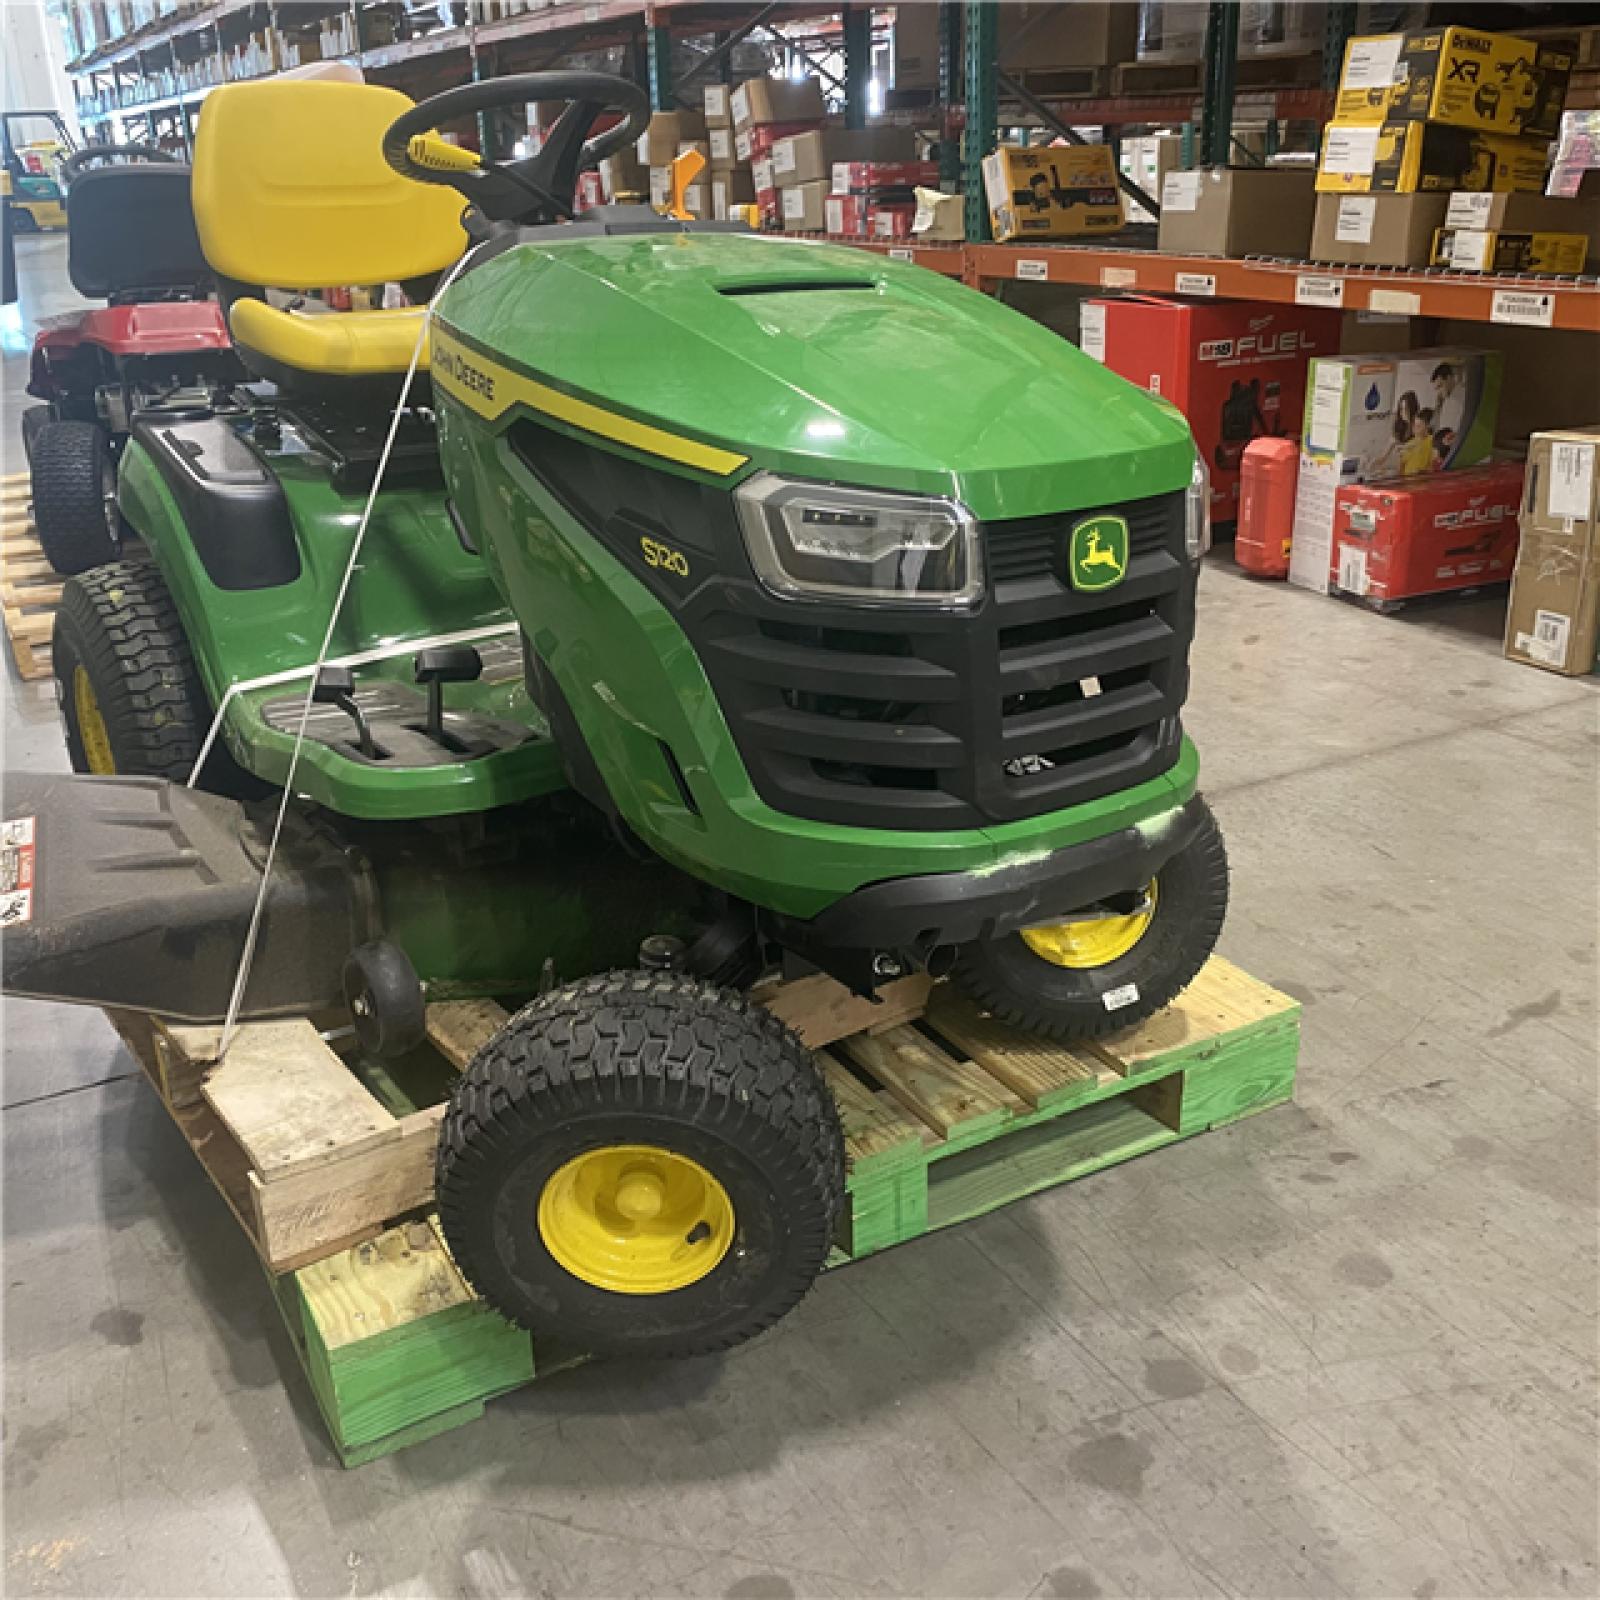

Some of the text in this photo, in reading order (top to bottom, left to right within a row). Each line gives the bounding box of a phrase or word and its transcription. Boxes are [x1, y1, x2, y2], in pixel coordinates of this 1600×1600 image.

[1447, 57, 1480, 83] XR
[1235, 329, 1316, 356] FUEL
[456, 354, 496, 401] DEERE
